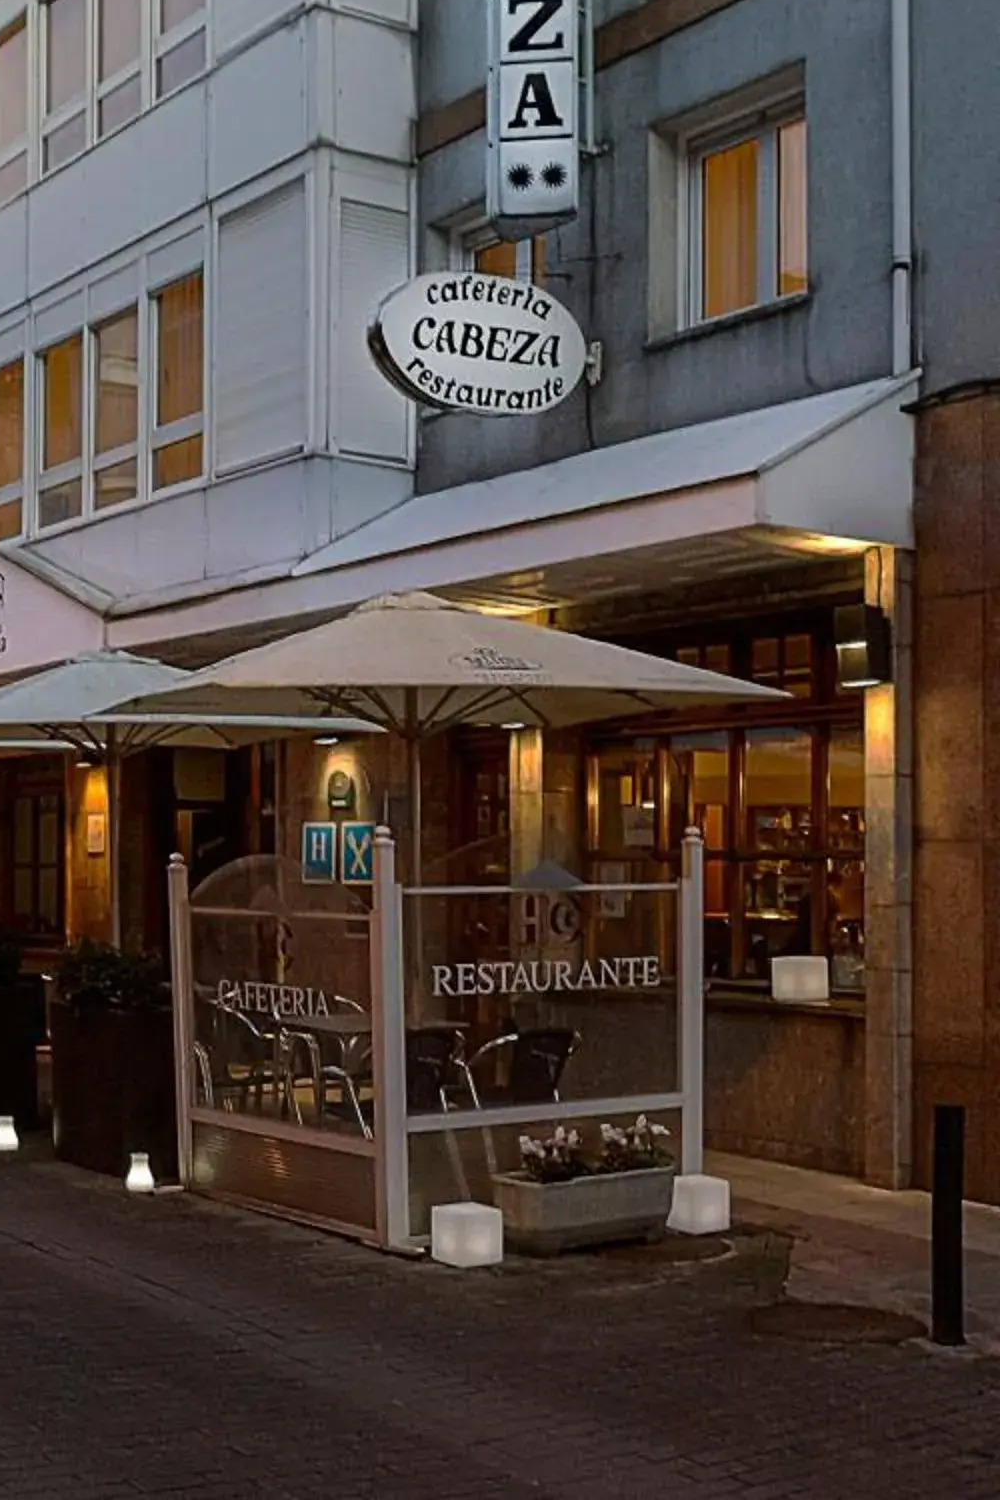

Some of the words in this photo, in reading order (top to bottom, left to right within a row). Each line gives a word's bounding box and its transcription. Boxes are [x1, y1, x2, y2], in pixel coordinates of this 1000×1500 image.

[413, 316, 561, 369] CABEZA
[406, 356, 565, 410] restaurante
[311, 830, 326, 862] H
[431, 955, 662, 997] RESTAURANTE
[217, 978, 330, 1019] CAFETERIA
